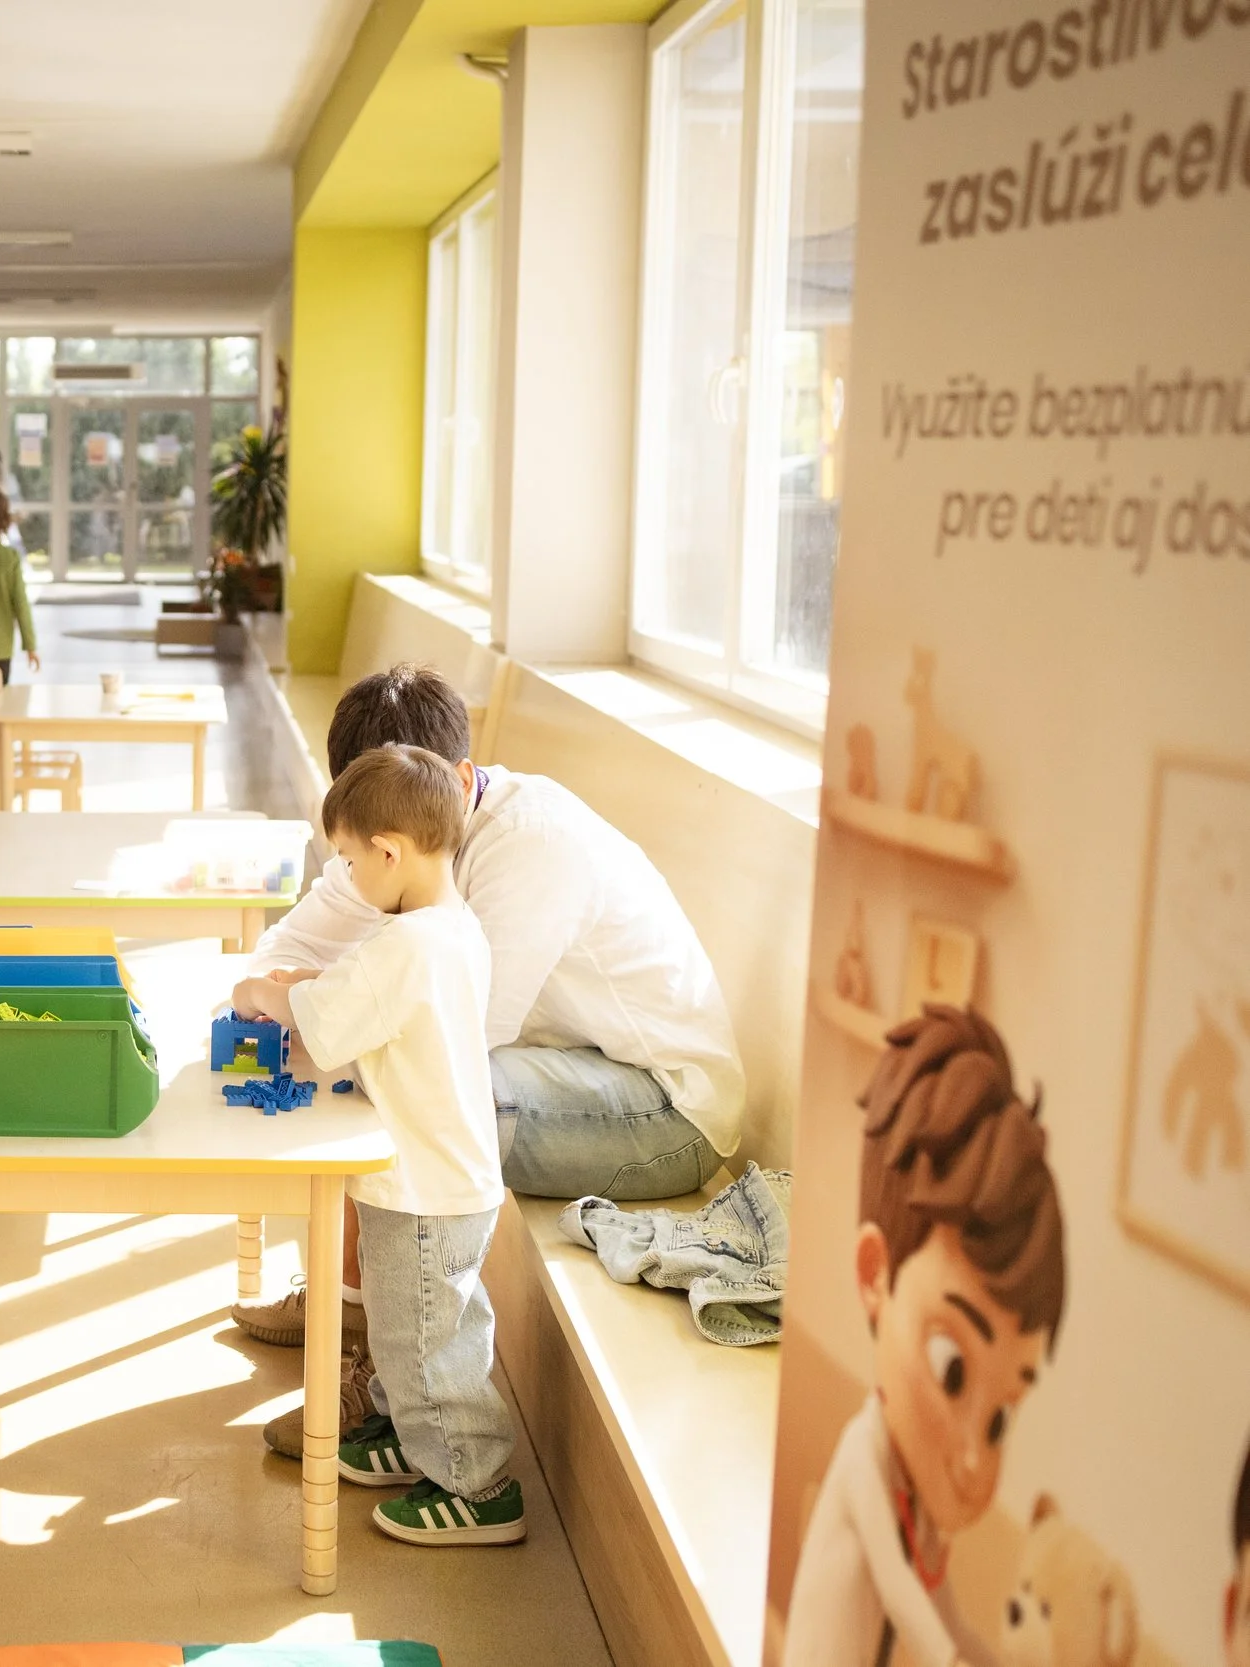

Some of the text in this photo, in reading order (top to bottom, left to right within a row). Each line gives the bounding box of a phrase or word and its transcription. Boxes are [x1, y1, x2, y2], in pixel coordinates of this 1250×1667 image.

[920, 110, 1134, 245] zaslúži
[881, 372, 1018, 459] Využite
[934, 490, 1017, 557] pre
[1026, 477, 1112, 547] deti
[1113, 475, 1163, 574] aj
